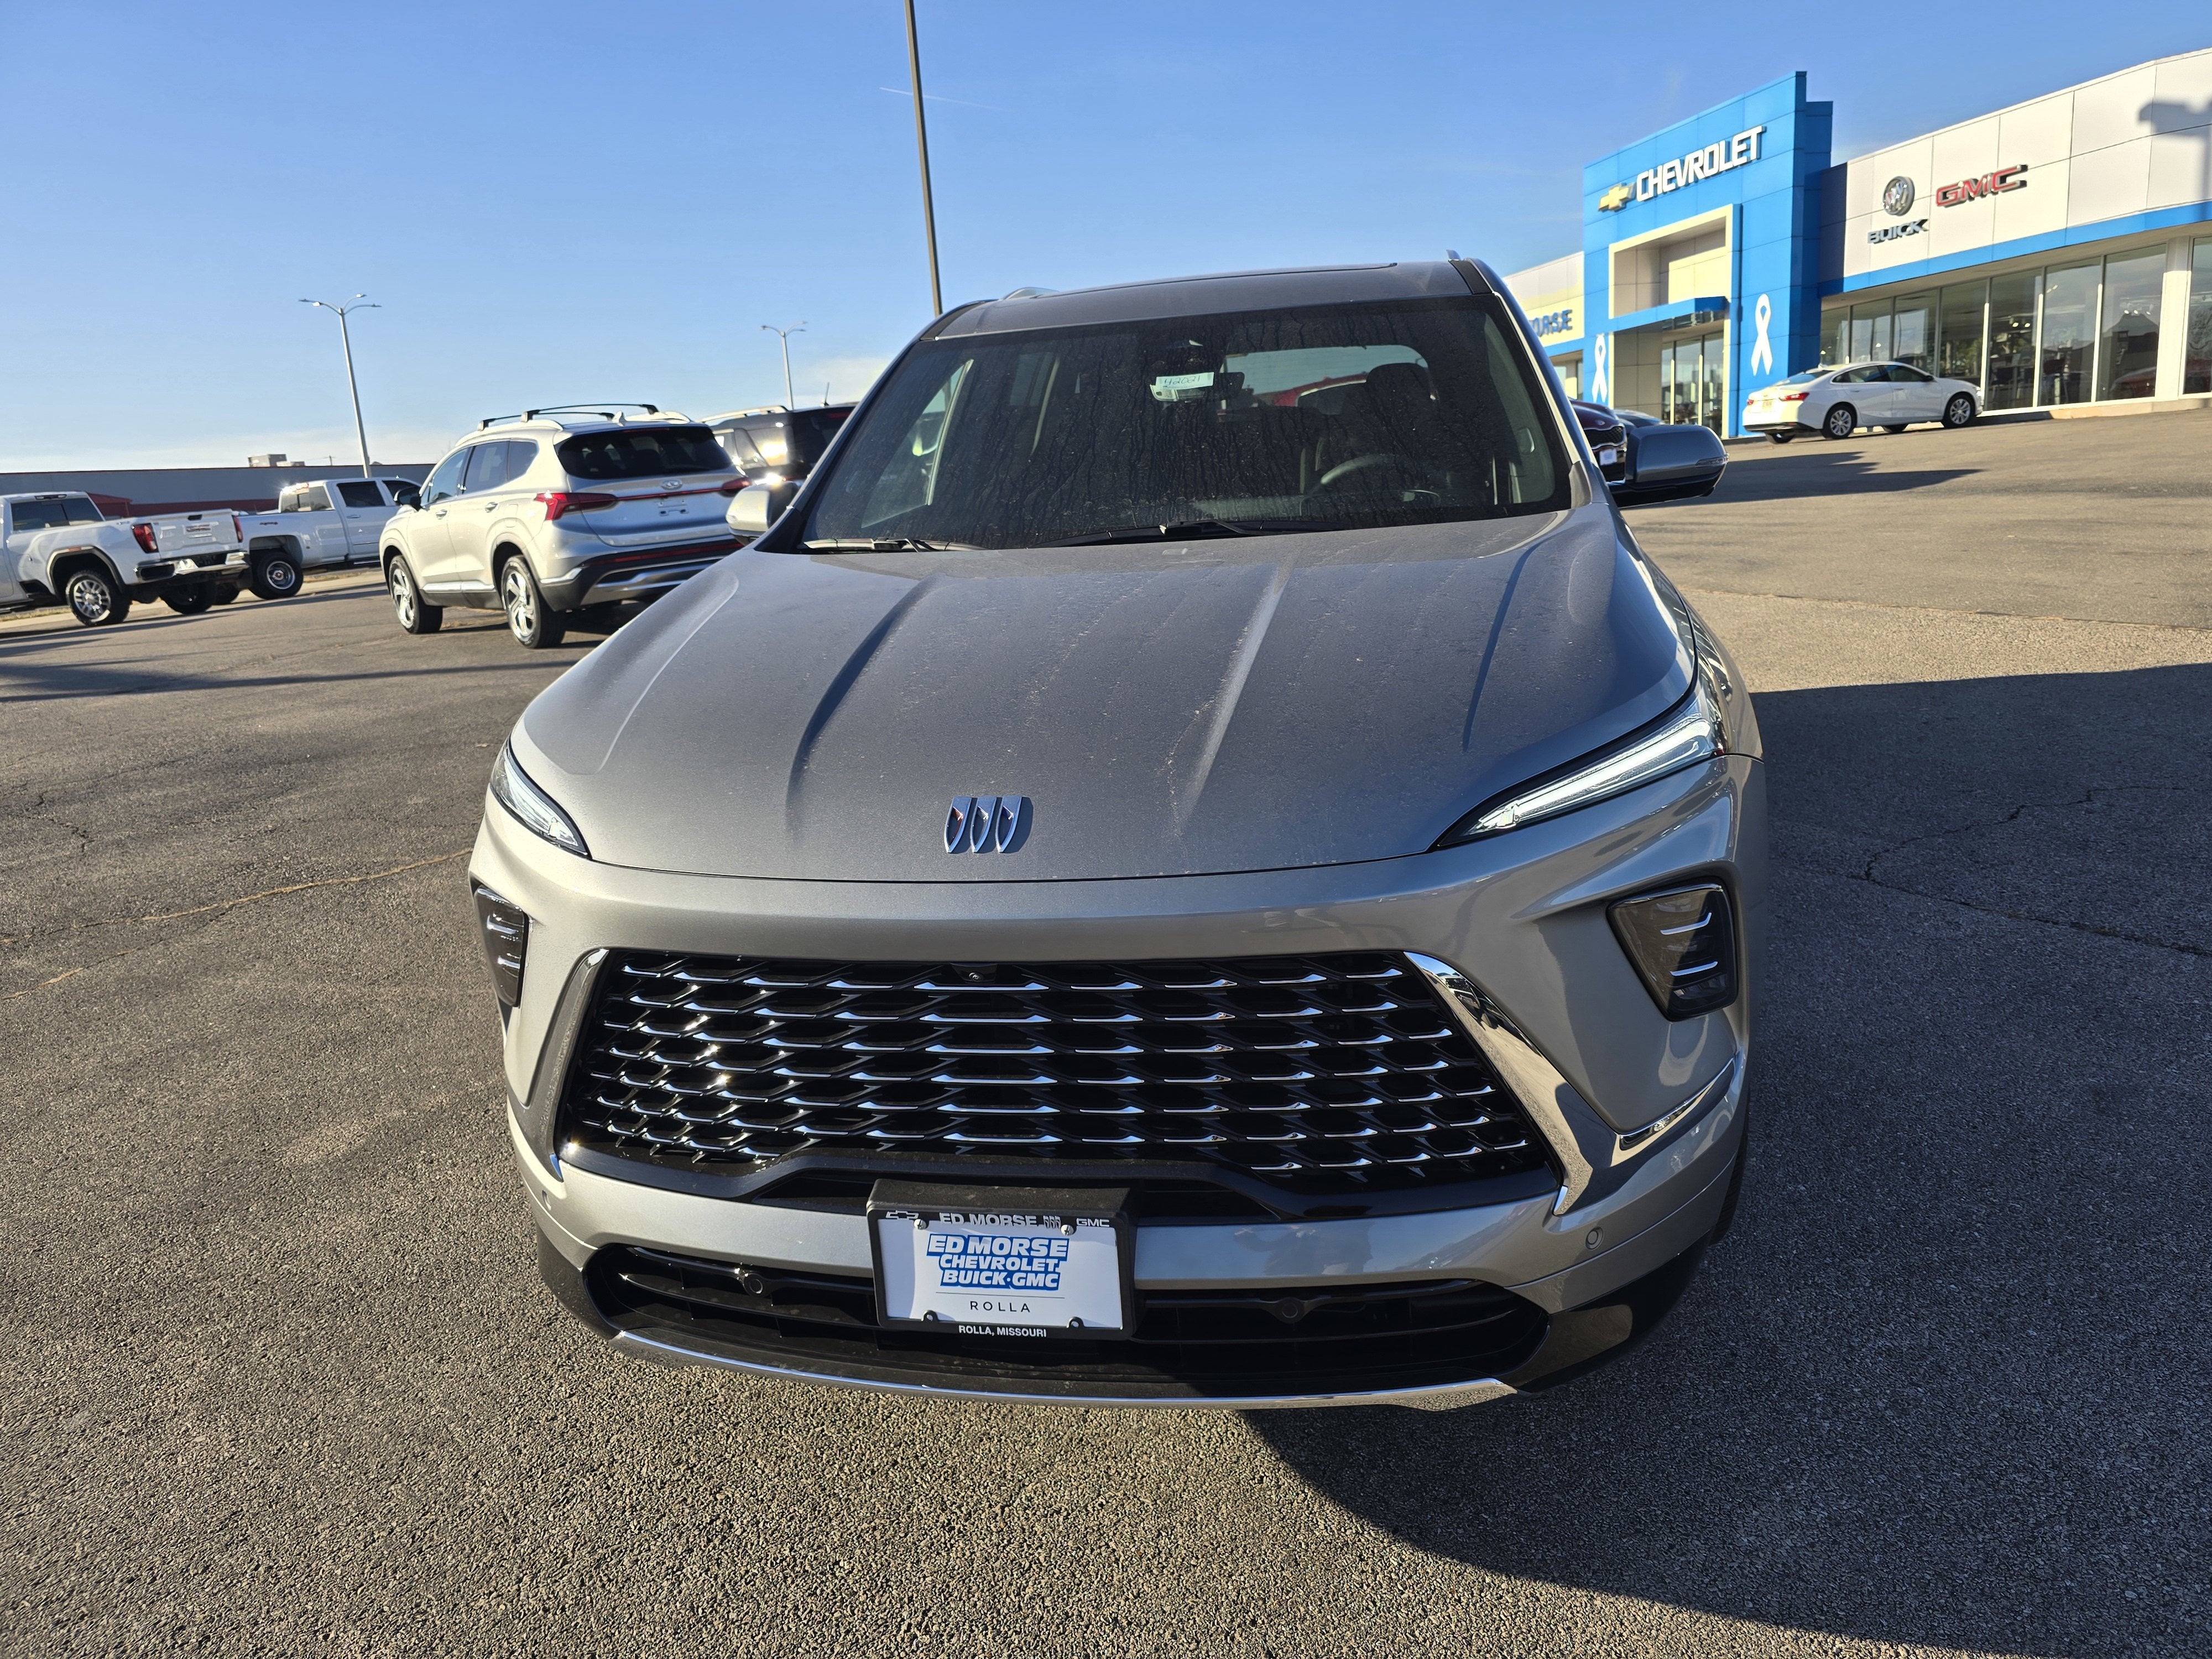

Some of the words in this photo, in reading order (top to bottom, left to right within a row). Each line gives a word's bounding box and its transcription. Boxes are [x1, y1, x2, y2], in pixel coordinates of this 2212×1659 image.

[1636, 126, 1766, 202] CHEVROLET
[1936, 164, 2028, 207] GMC
[1867, 219, 1928, 244] BUICK
[1530, 309, 1573, 337] ORSE
[940, 1212, 964, 1225] ED
[969, 1213, 1037, 1227] MORSE
[1076, 1218, 1110, 1228] GMC
[928, 1235, 964, 1253] ED
[967, 1237, 1068, 1257] MORSE
[940, 1254, 1058, 1271] CHEVROLET
[970, 1301, 1030, 1313] ROLLA
[958, 1325, 995, 1337] ROLLA,
[997, 1327, 1047, 1338] MISSOURI
